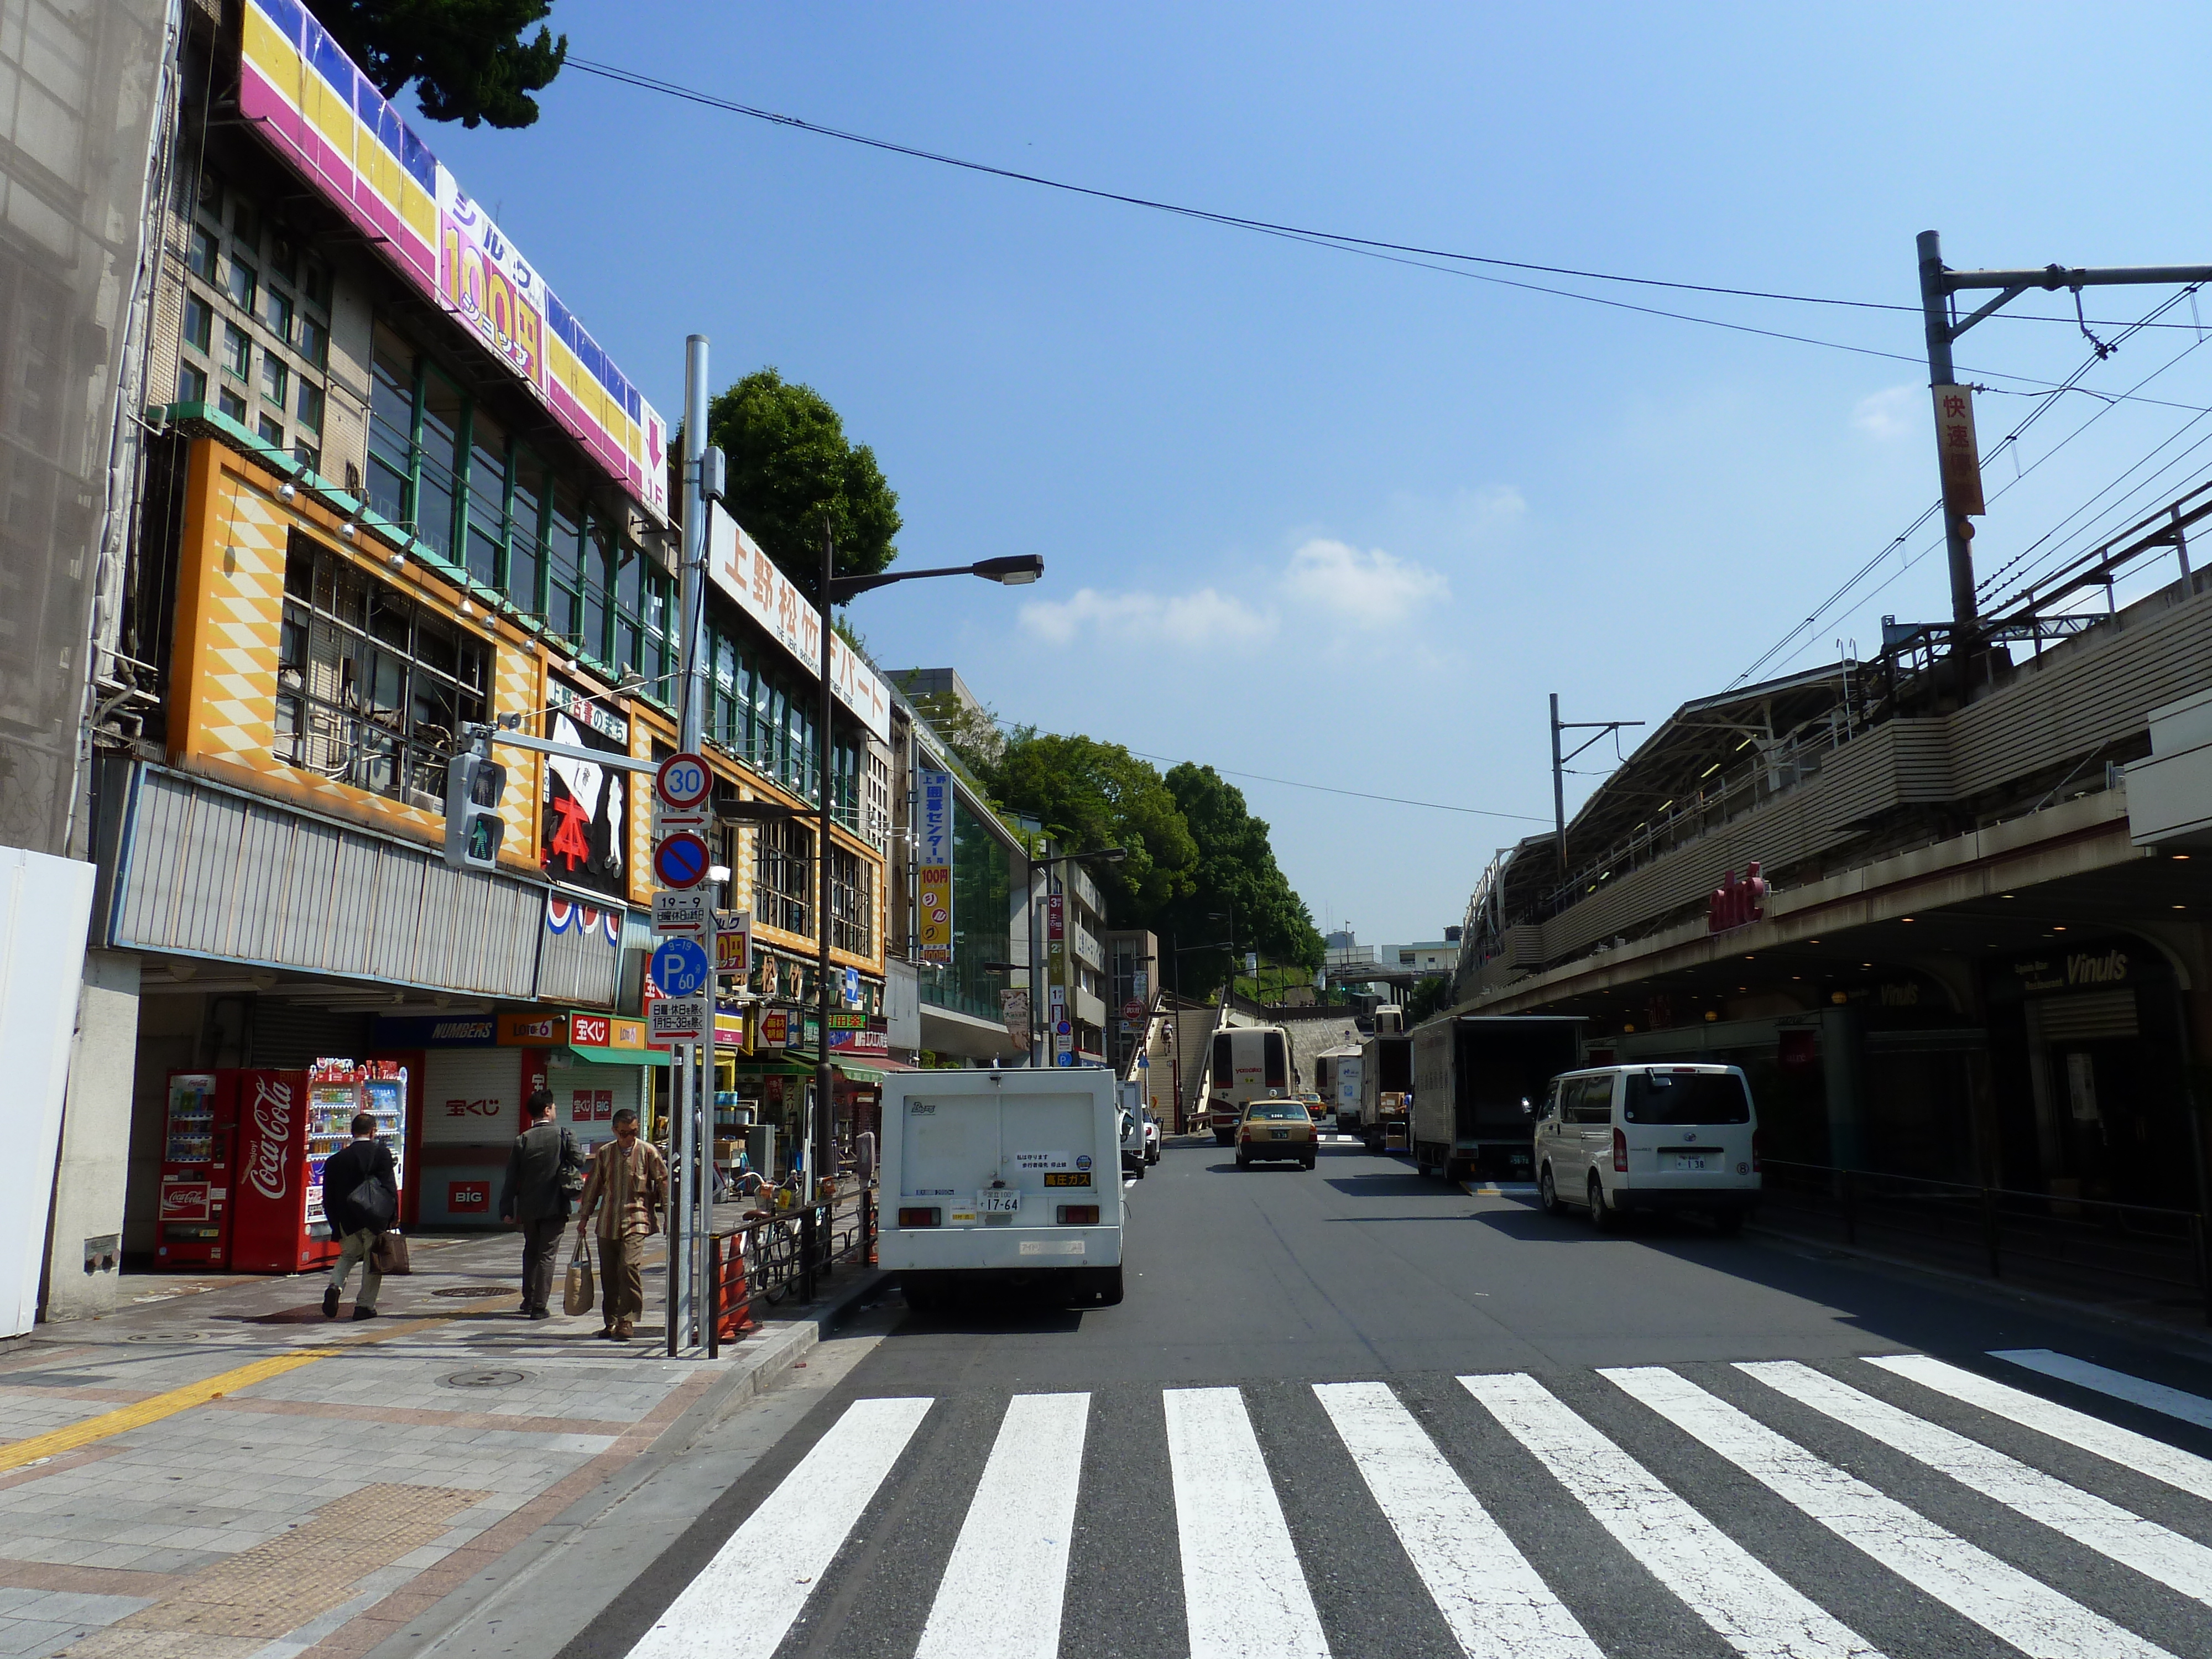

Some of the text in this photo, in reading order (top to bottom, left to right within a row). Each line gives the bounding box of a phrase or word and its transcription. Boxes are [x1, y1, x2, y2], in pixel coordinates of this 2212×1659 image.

[453, 191, 531, 289] シルク
[445, 226, 538, 387] 100円
[462, 290, 529, 366] ショップ
[550, 681, 623, 742] 上野古書のまち
[670, 769, 700, 793] 30
[922, 869, 948, 884] 100円
[717, 916, 740, 930] ルク
[668, 941, 692, 951] 9-19
[924, 950, 946, 962] 100円
[664, 954, 686, 990] P
[2067, 950, 2128, 984] Vinuls
[679, 974, 695, 989] 60
[432, 1022, 493, 1039] NUMBERS
[576, 1019, 605, 1042] 宝くじ
[446, 1099, 499, 1117] 宝くじ
[574, 1099, 591, 1113] 宝くじ
[251, 1075, 294, 1199] Coca-Cola
[1046, 1175, 1089, 1185] 高圧ガス
[988, 1198, 1018, 1211] 17-64
